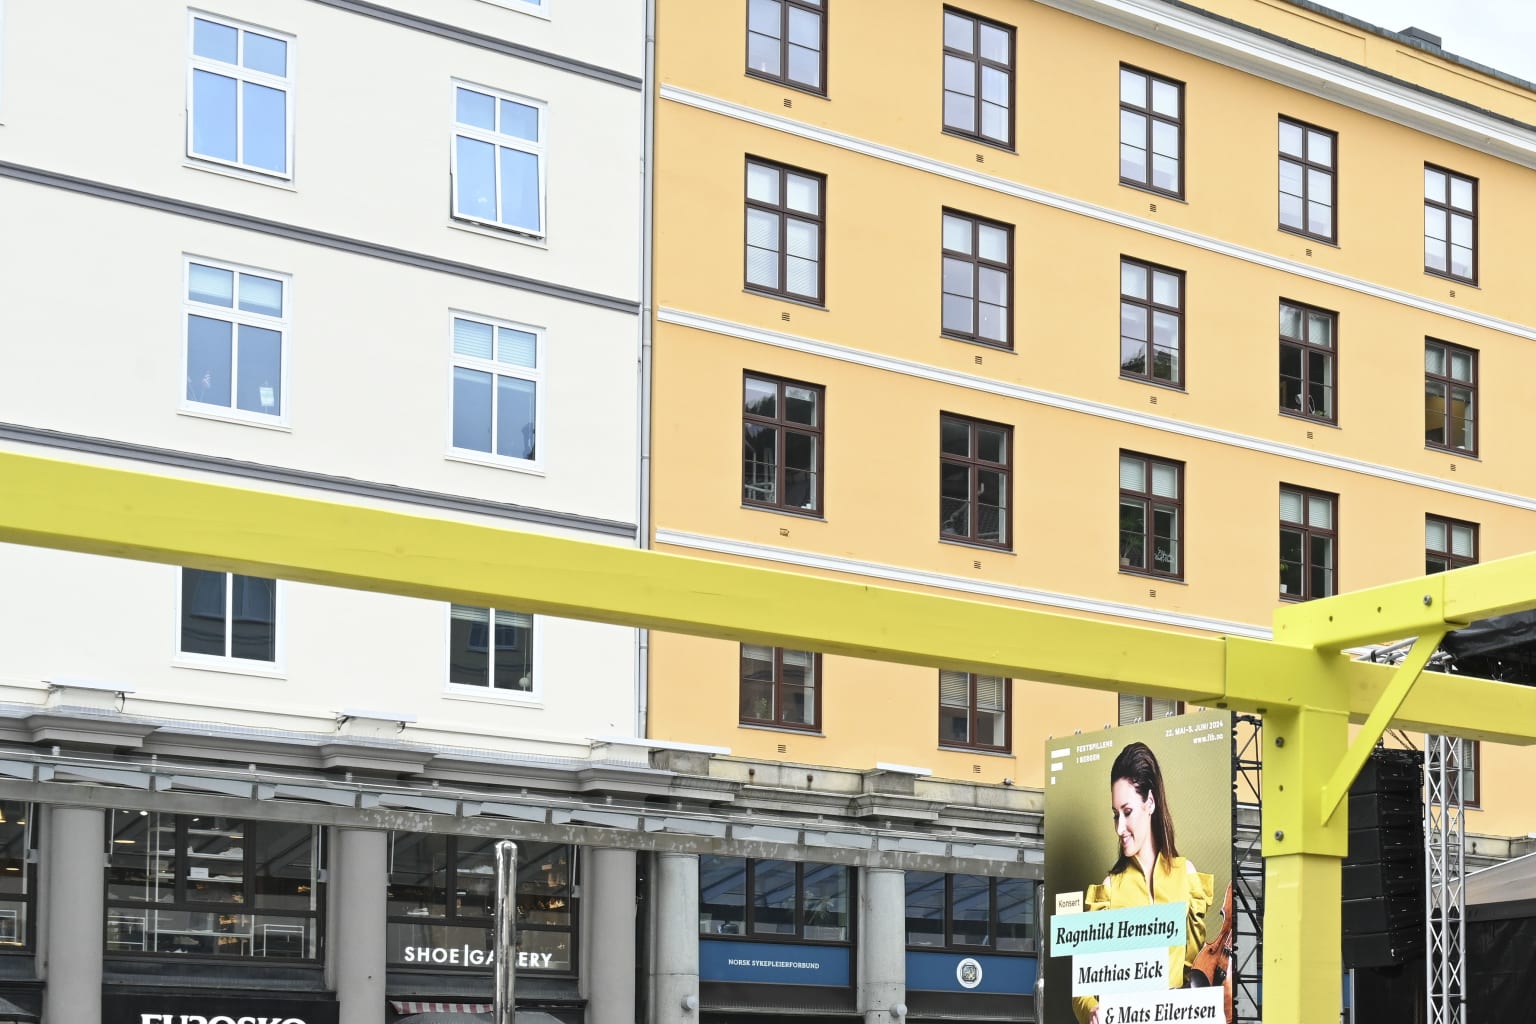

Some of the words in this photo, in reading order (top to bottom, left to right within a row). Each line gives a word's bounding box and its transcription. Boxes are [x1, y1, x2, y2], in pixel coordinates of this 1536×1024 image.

[1058, 900, 1080, 909] Konsert
[1056, 922, 1114, 948] Ragnhild
[1117, 917, 1179, 940] Hemsing,
[404, 946, 460, 964] SHOE
[728, 958, 751, 966] NORSK
[751, 960, 820, 969] SYKEPLEIERFORBUND
[1078, 963, 1131, 984] Mathias
[1134, 960, 1163, 980] Eick
[1105, 1007, 1114, 1024] &
[1117, 1004, 1151, 1024] Mats
[1154, 1002, 1216, 1022] Eilertsen
